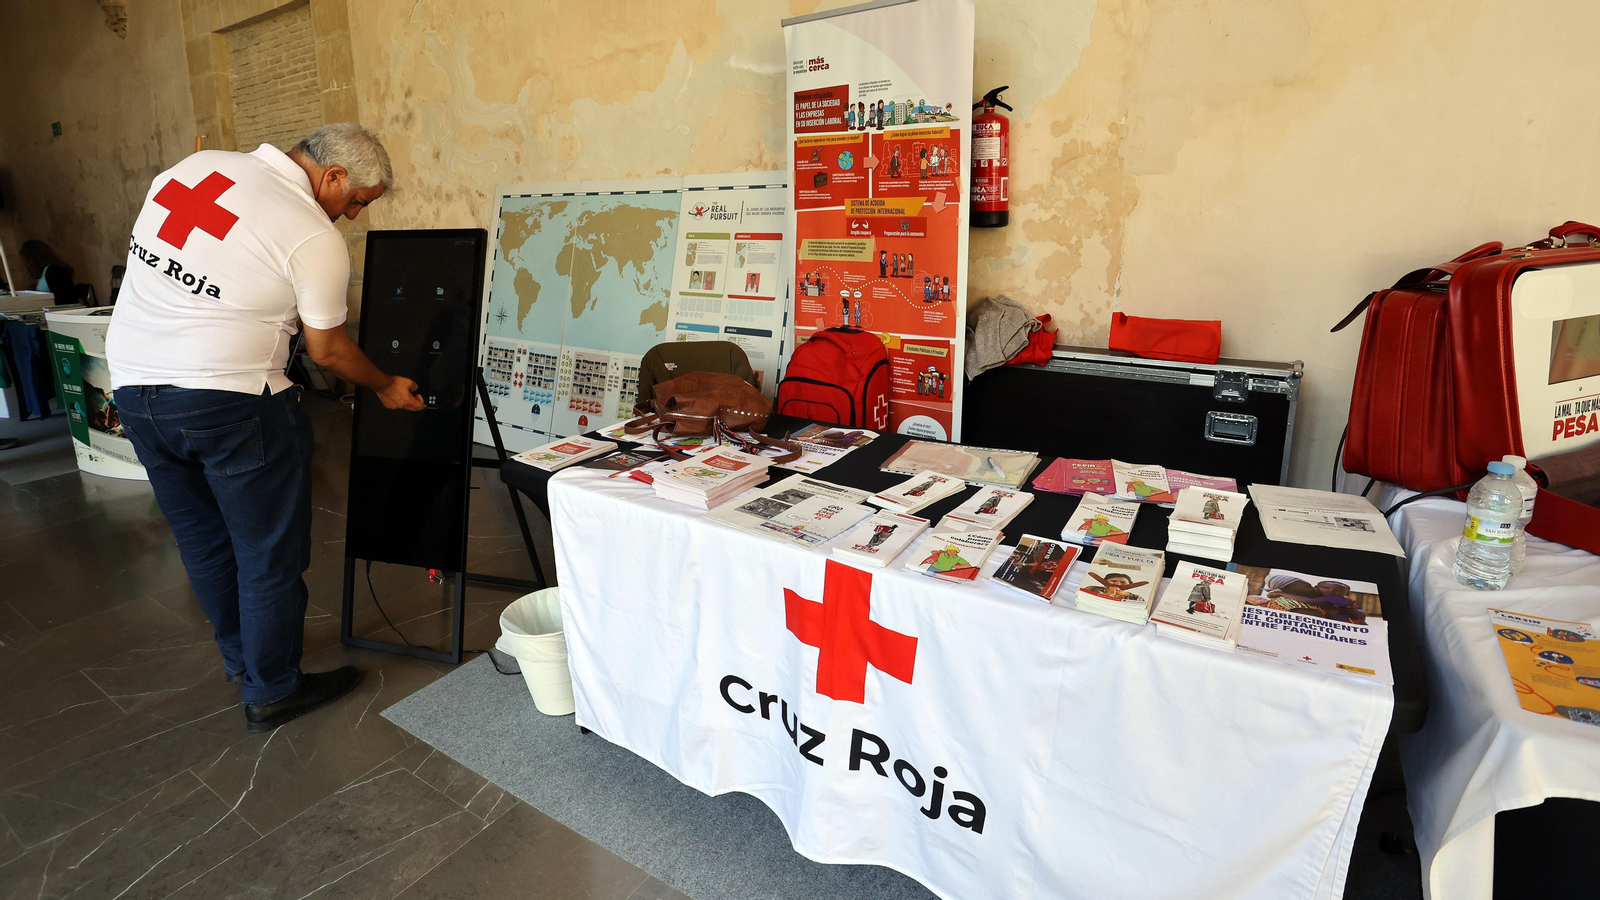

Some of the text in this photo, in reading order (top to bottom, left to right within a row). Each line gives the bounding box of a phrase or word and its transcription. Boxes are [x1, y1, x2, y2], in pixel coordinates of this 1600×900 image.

[808, 56, 825, 66] más
[808, 62, 830, 72] cerca
[800, 101, 811, 110] PAPEL
[821, 99, 841, 107] SOCIEDAD
[805, 109, 825, 118] EMPRESAS
[795, 120, 800, 128] EN
[805, 118, 825, 127] INSERCIÓN
[825, 117, 842, 125] LABORAL
[711, 205, 727, 213] REAL
[710, 212, 738, 221] PURSUIT
[163, 258, 220, 299] Roja
[1555, 405, 1561, 418] LA
[1581, 399, 1591, 415] QUE
[1592, 396, 1600, 411] MÁ
[1552, 413, 1599, 441] PESA
[991, 490, 1013, 498] PESA
[1203, 494, 1229, 502] PESA
[1096, 507, 1134, 516] colaborar?
[950, 536, 989, 546] colaborar?
[1191, 572, 1224, 585] PESA
[1265, 615, 1335, 635] CONTACTO
[1283, 625, 1368, 646] FAMILIARES
[719, 674, 987, 834] Cruz Roja
